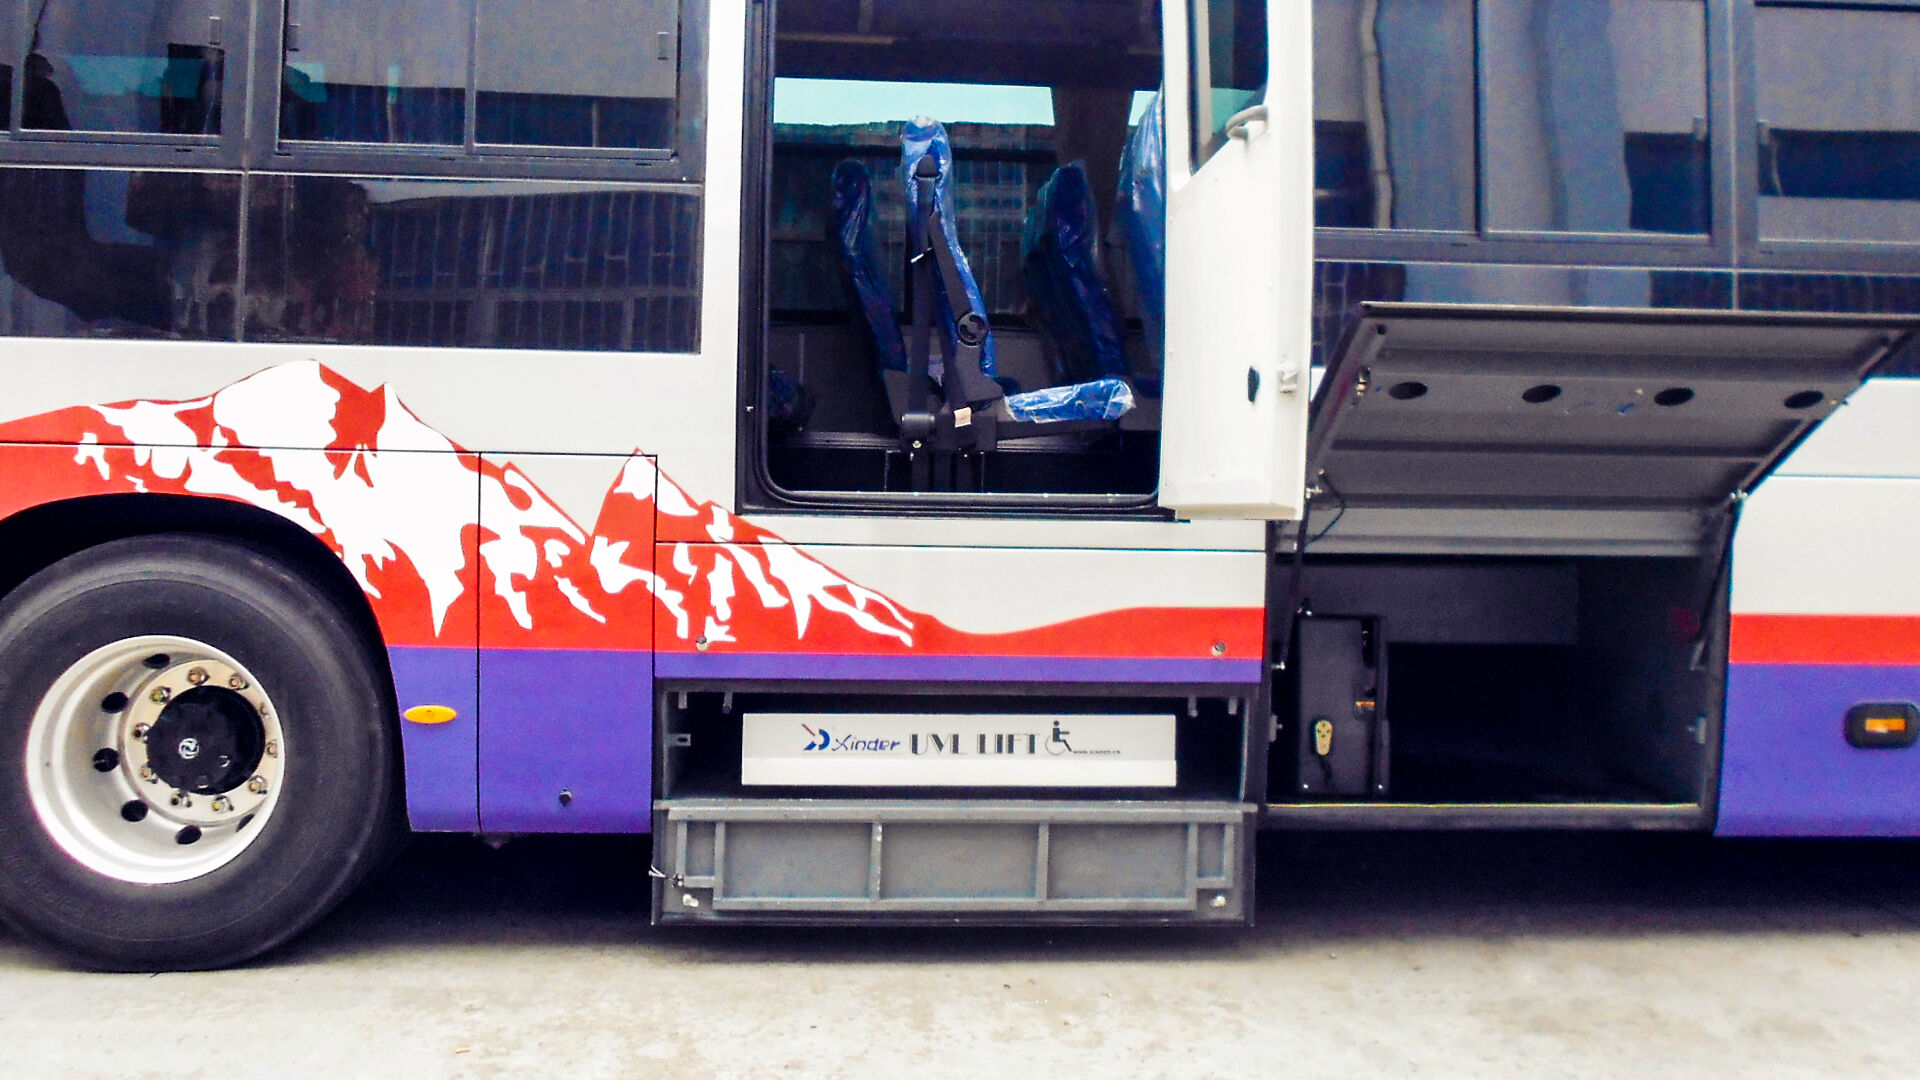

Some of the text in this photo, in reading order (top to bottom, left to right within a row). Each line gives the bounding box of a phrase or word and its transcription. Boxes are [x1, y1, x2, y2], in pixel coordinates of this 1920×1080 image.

[832, 733, 1040, 755] Xinder UVL LIFT
